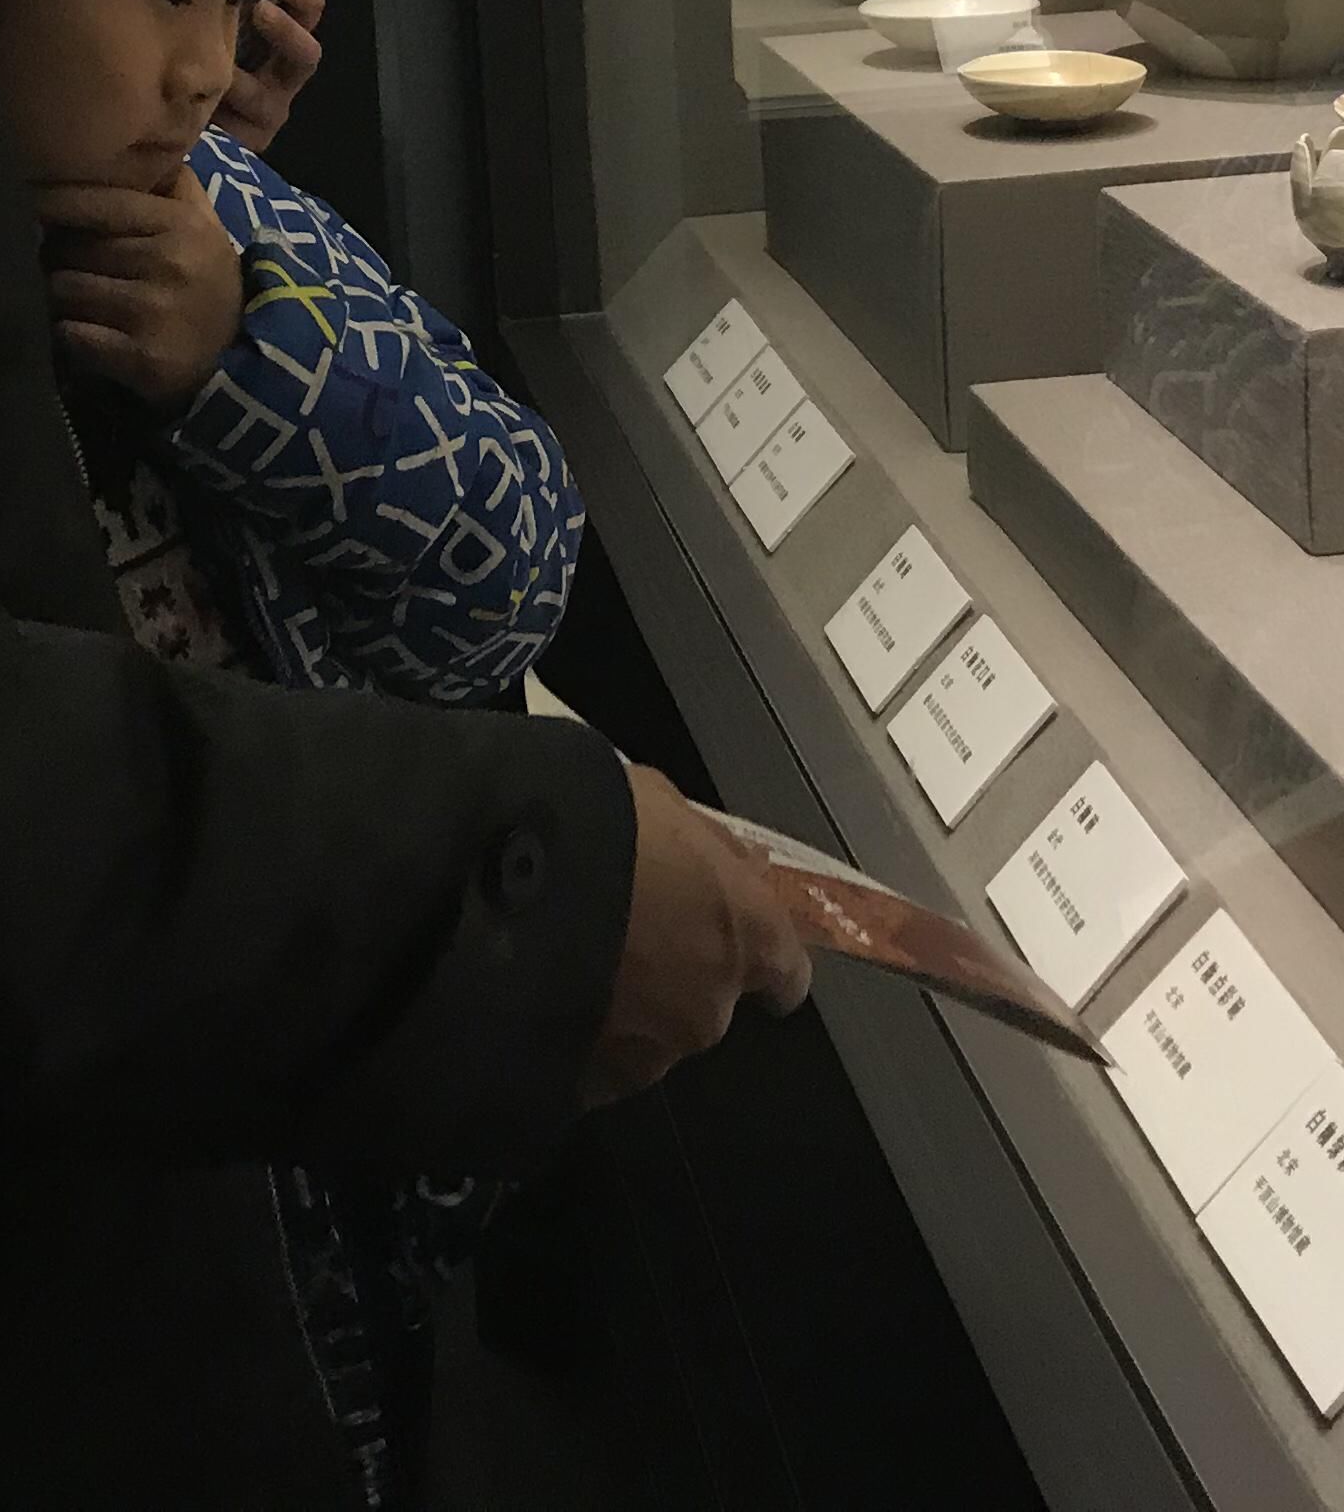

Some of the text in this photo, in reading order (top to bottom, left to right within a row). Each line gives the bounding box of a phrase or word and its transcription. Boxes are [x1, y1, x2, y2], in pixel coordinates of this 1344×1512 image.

[1276, 1148, 1299, 1177] 北宋
[1254, 1175, 1312, 1257] 平顶山博物馆藏
